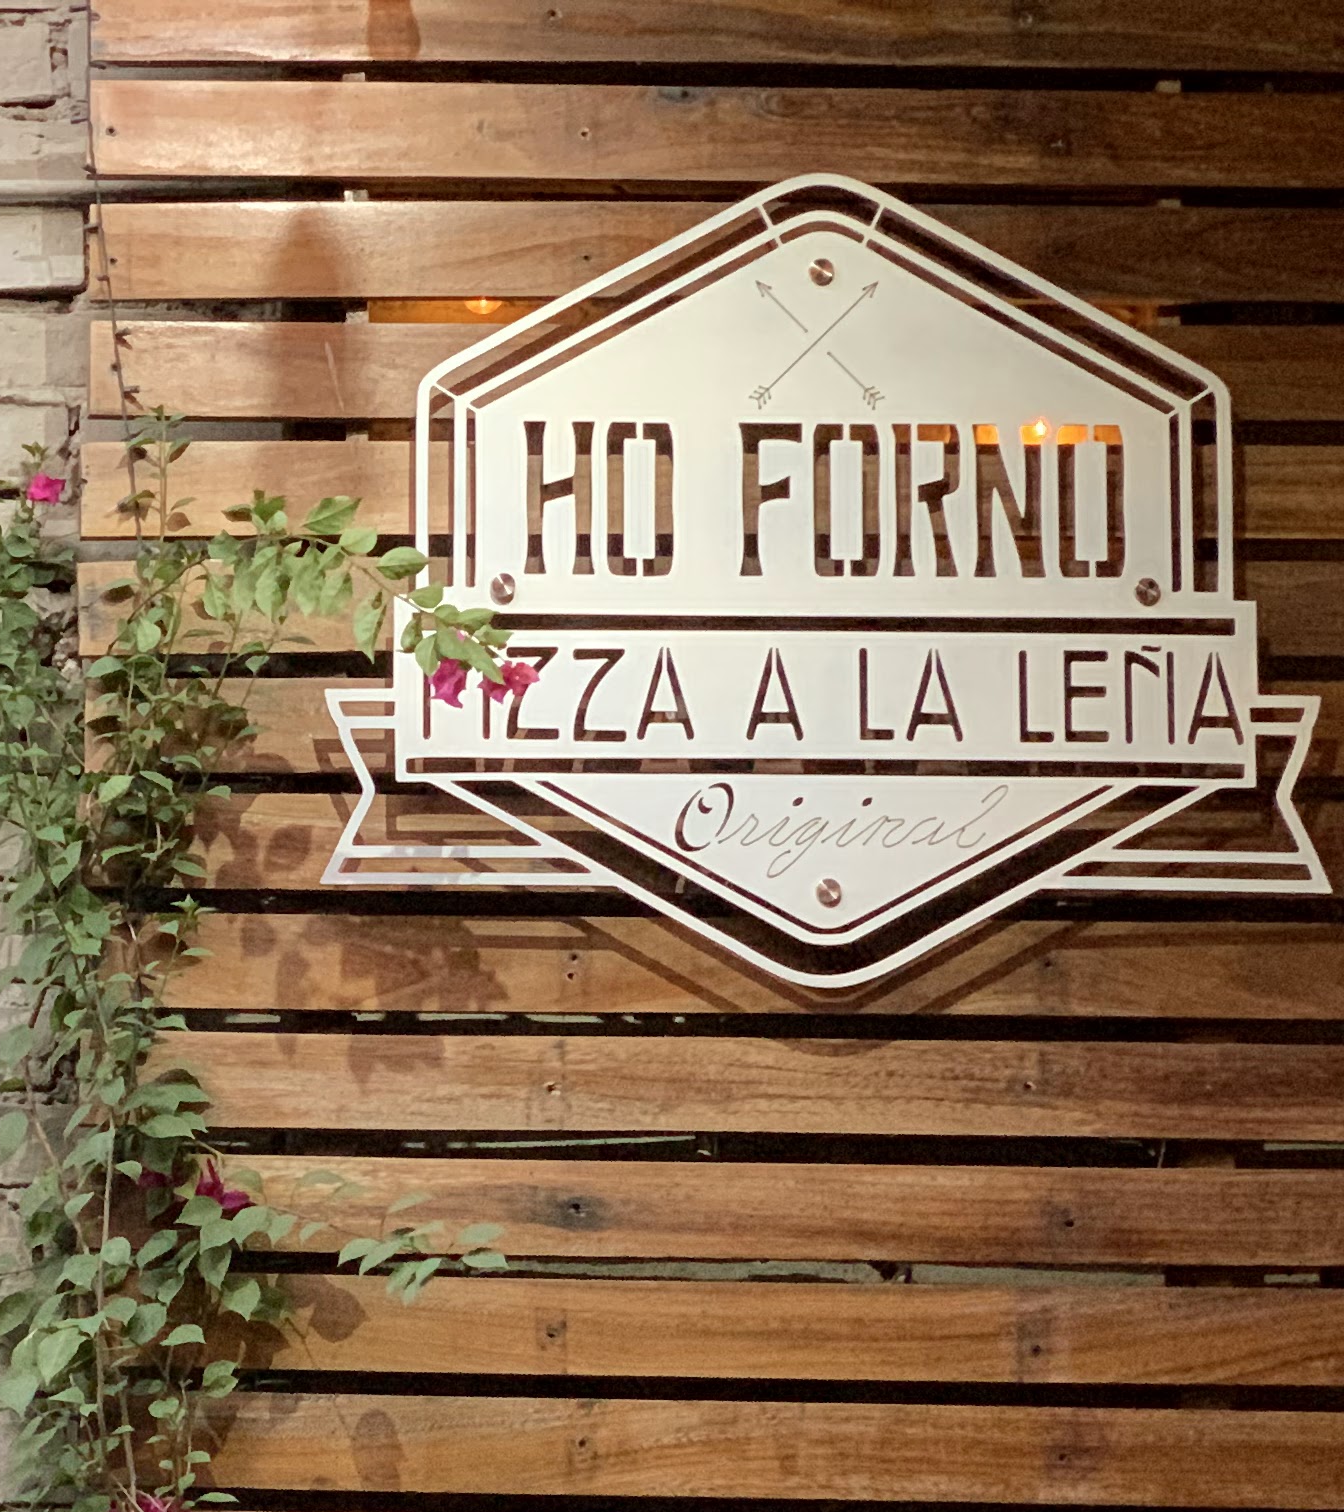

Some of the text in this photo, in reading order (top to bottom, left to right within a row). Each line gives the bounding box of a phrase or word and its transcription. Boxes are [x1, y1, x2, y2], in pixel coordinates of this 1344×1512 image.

[524, 420, 1126, 578] HO FORNO
[746, 647, 804, 742] A
[859, 647, 964, 743] LA
[1018, 645, 1245, 746] LEÑA
[674, 781, 1009, 878] Original
